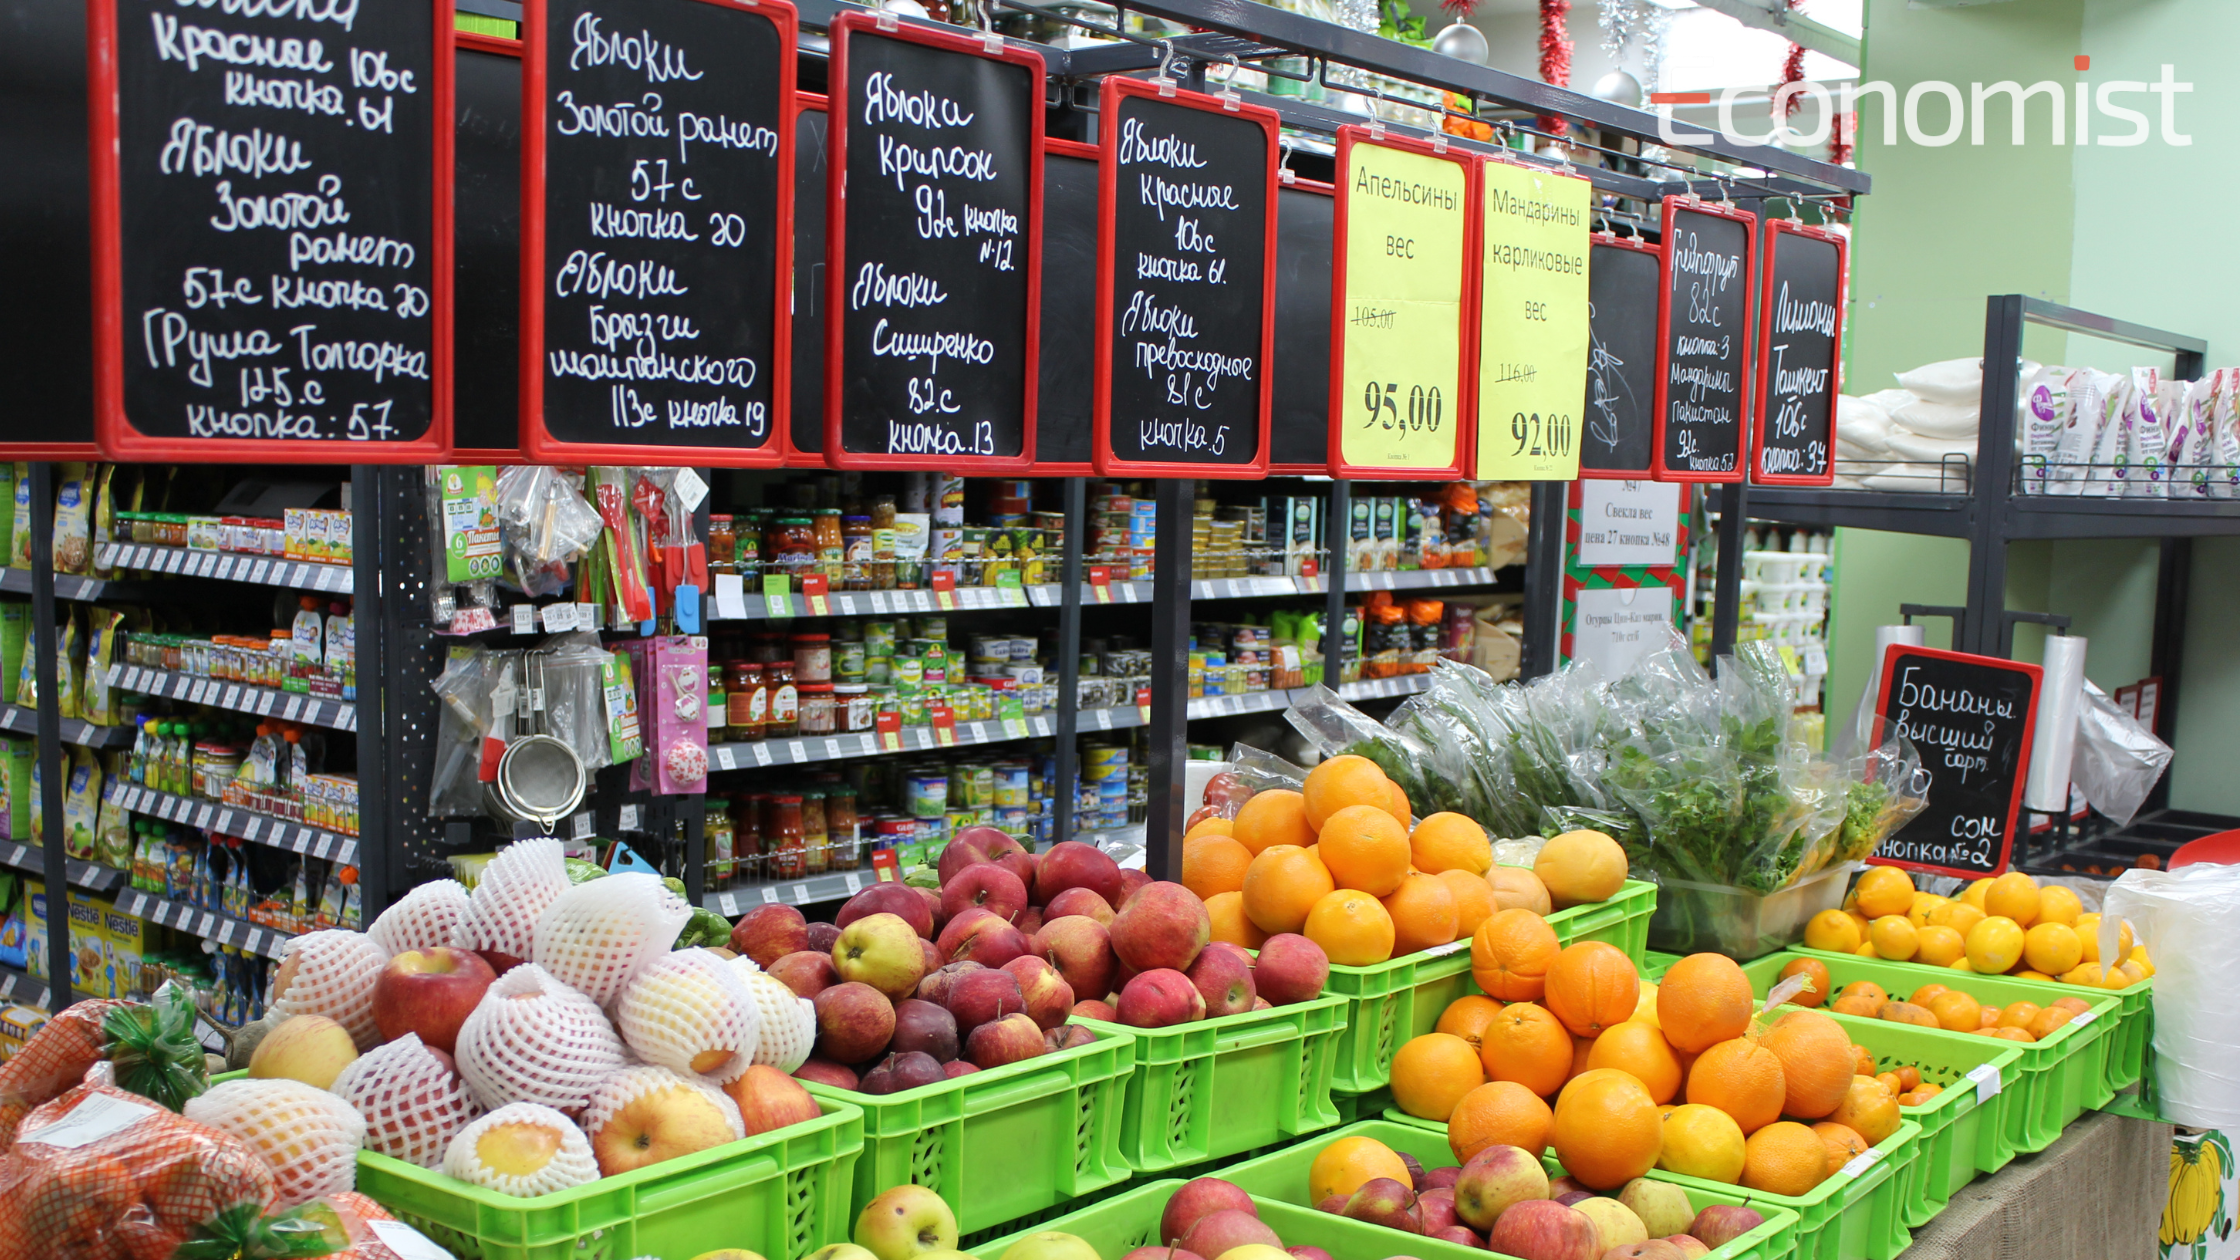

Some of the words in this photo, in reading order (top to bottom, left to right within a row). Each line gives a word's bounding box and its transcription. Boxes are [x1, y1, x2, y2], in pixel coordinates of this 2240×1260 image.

[570, 12, 704, 83] Яблоки
[865, 71, 974, 129] Яблоки
[161, 117, 312, 179] Яблоки
[557, 91, 670, 138] Золотой
[678, 112, 778, 163] ранет
[1120, 117, 1207, 169] Яблоки
[211, 174, 350, 231] Золотой
[1356, 166, 1458, 211] Апельсины
[1493, 188, 1580, 227] Мандарины
[710, 213, 746, 247] 20
[1386, 235, 1415, 259] вес
[556, 250, 689, 299] Яблоки
[1493, 243, 1583, 275] карликовые
[394, 283, 429, 319] 20
[853, 261, 948, 310] Яблоки
[1122, 290, 1198, 339] Яблоки
[1525, 300, 1547, 322] вес
[144, 308, 282, 388] Груша
[1773, 344, 1828, 398] Ташкент
[745, 400, 766, 437] 19
[1363, 381, 1442, 441] 95,00
[1672, 400, 1732, 424] Пакистан
[1511, 412, 1571, 462] 92,00
[1606, 502, 1637, 518] Свекла
[1640, 509, 1653, 520] вес
[456, 535, 463, 549] 6
[467, 530, 500, 544] Пакеты
[1585, 532, 1605, 543] цена
[1607, 530, 1618, 545] 27
[1620, 534, 1650, 545] кнопка
[1651, 532, 1670, 546] №48
[1585, 613, 1612, 628] Огурцы
